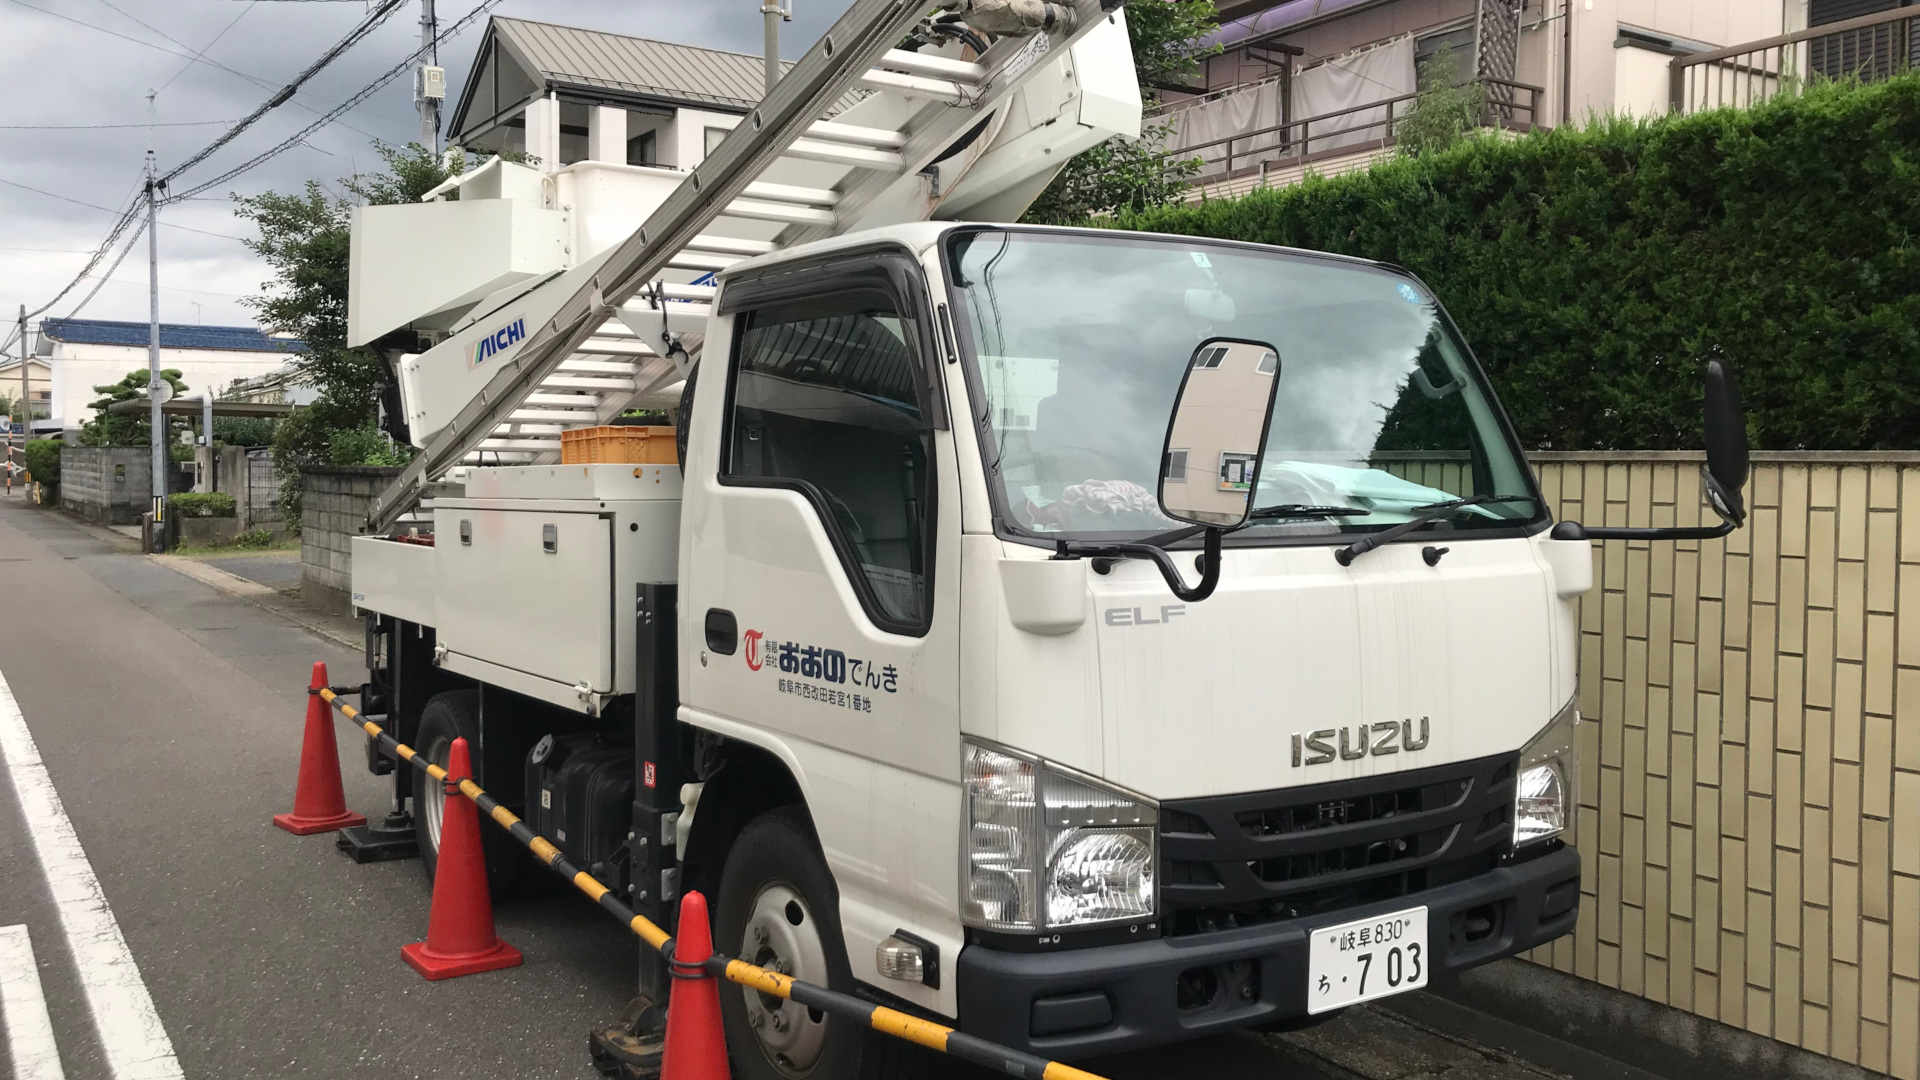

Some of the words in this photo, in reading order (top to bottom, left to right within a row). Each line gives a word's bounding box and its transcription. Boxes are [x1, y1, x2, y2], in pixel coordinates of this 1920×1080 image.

[476, 318, 525, 363] AICHI
[1105, 605, 1186, 626] ELF
[779, 641, 898, 693] おおのでんき
[1291, 716, 1430, 768] ISUZU
